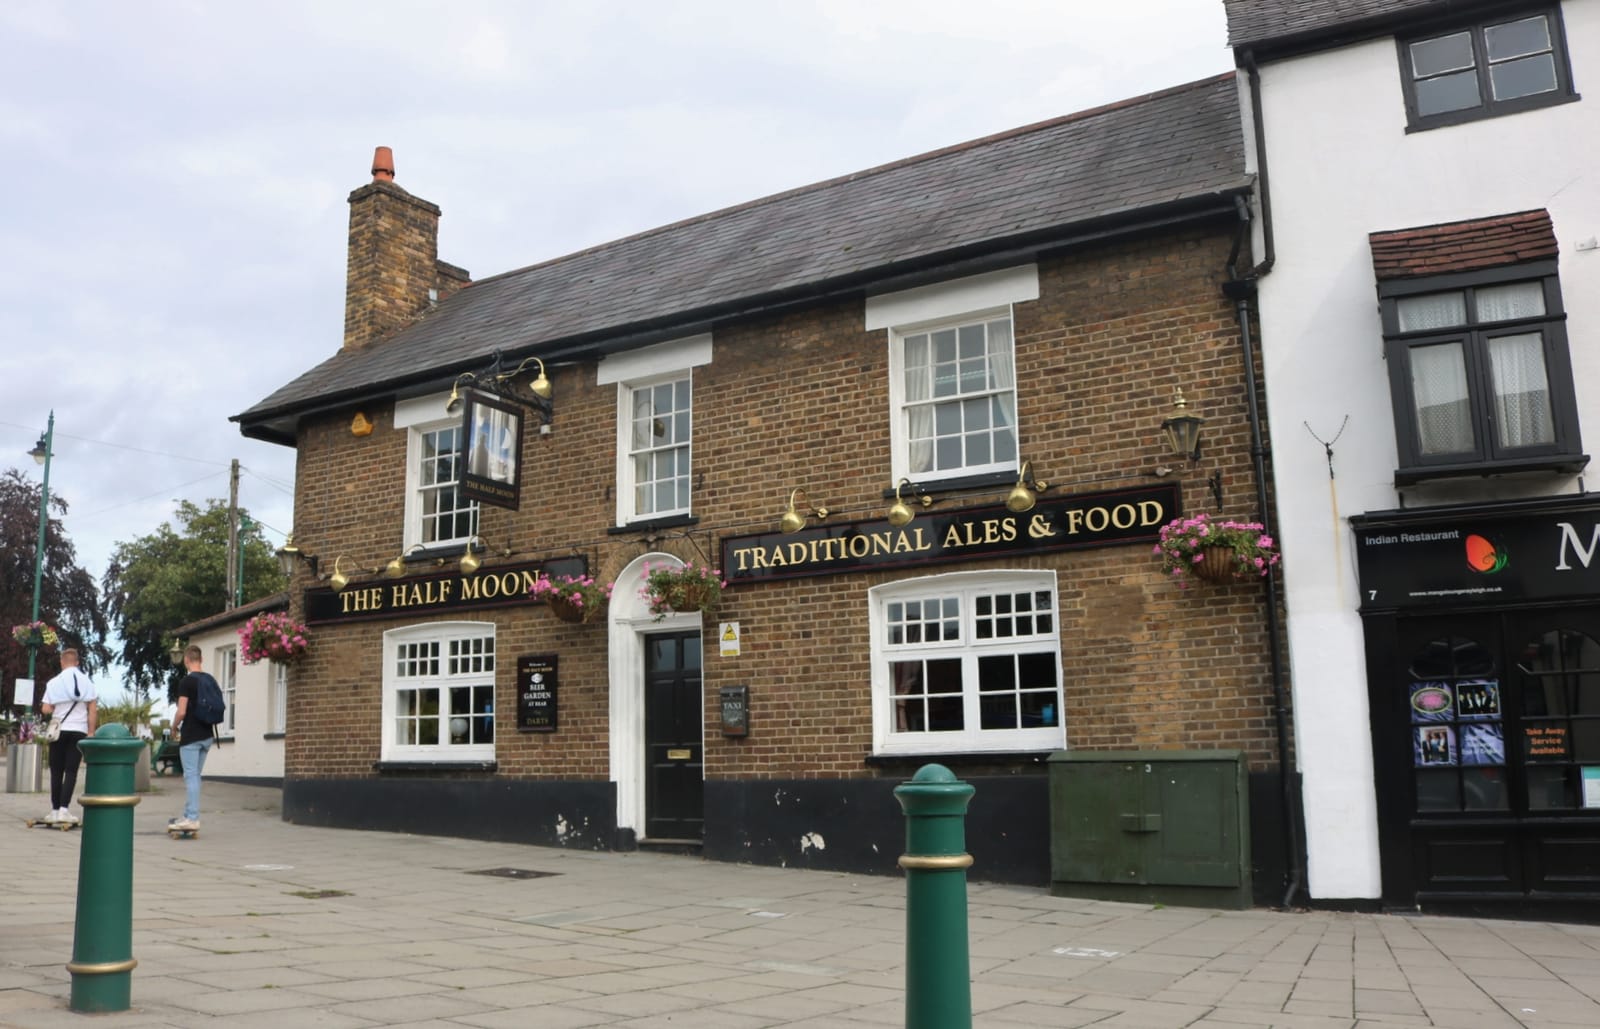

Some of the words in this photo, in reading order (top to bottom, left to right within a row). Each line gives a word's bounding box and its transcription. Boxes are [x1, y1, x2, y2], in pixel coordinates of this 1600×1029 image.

[734, 527, 932, 571] TRADITIONAL
[942, 517, 1017, 549] ALES
[1028, 514, 1056, 539] &
[1066, 500, 1164, 535] FOOD
[1365, 535, 1398, 546] Indian
[1400, 530, 1459, 543] Restaurant
[339, 587, 384, 613] THE
[391, 580, 452, 607] HALF
[461, 570, 540, 600] MOON
[1368, 590, 1377, 600] 7
[524, 692, 551, 700] GARDEN
[723, 702, 742, 710] TAXI
[1531, 737, 1562, 745] Service
